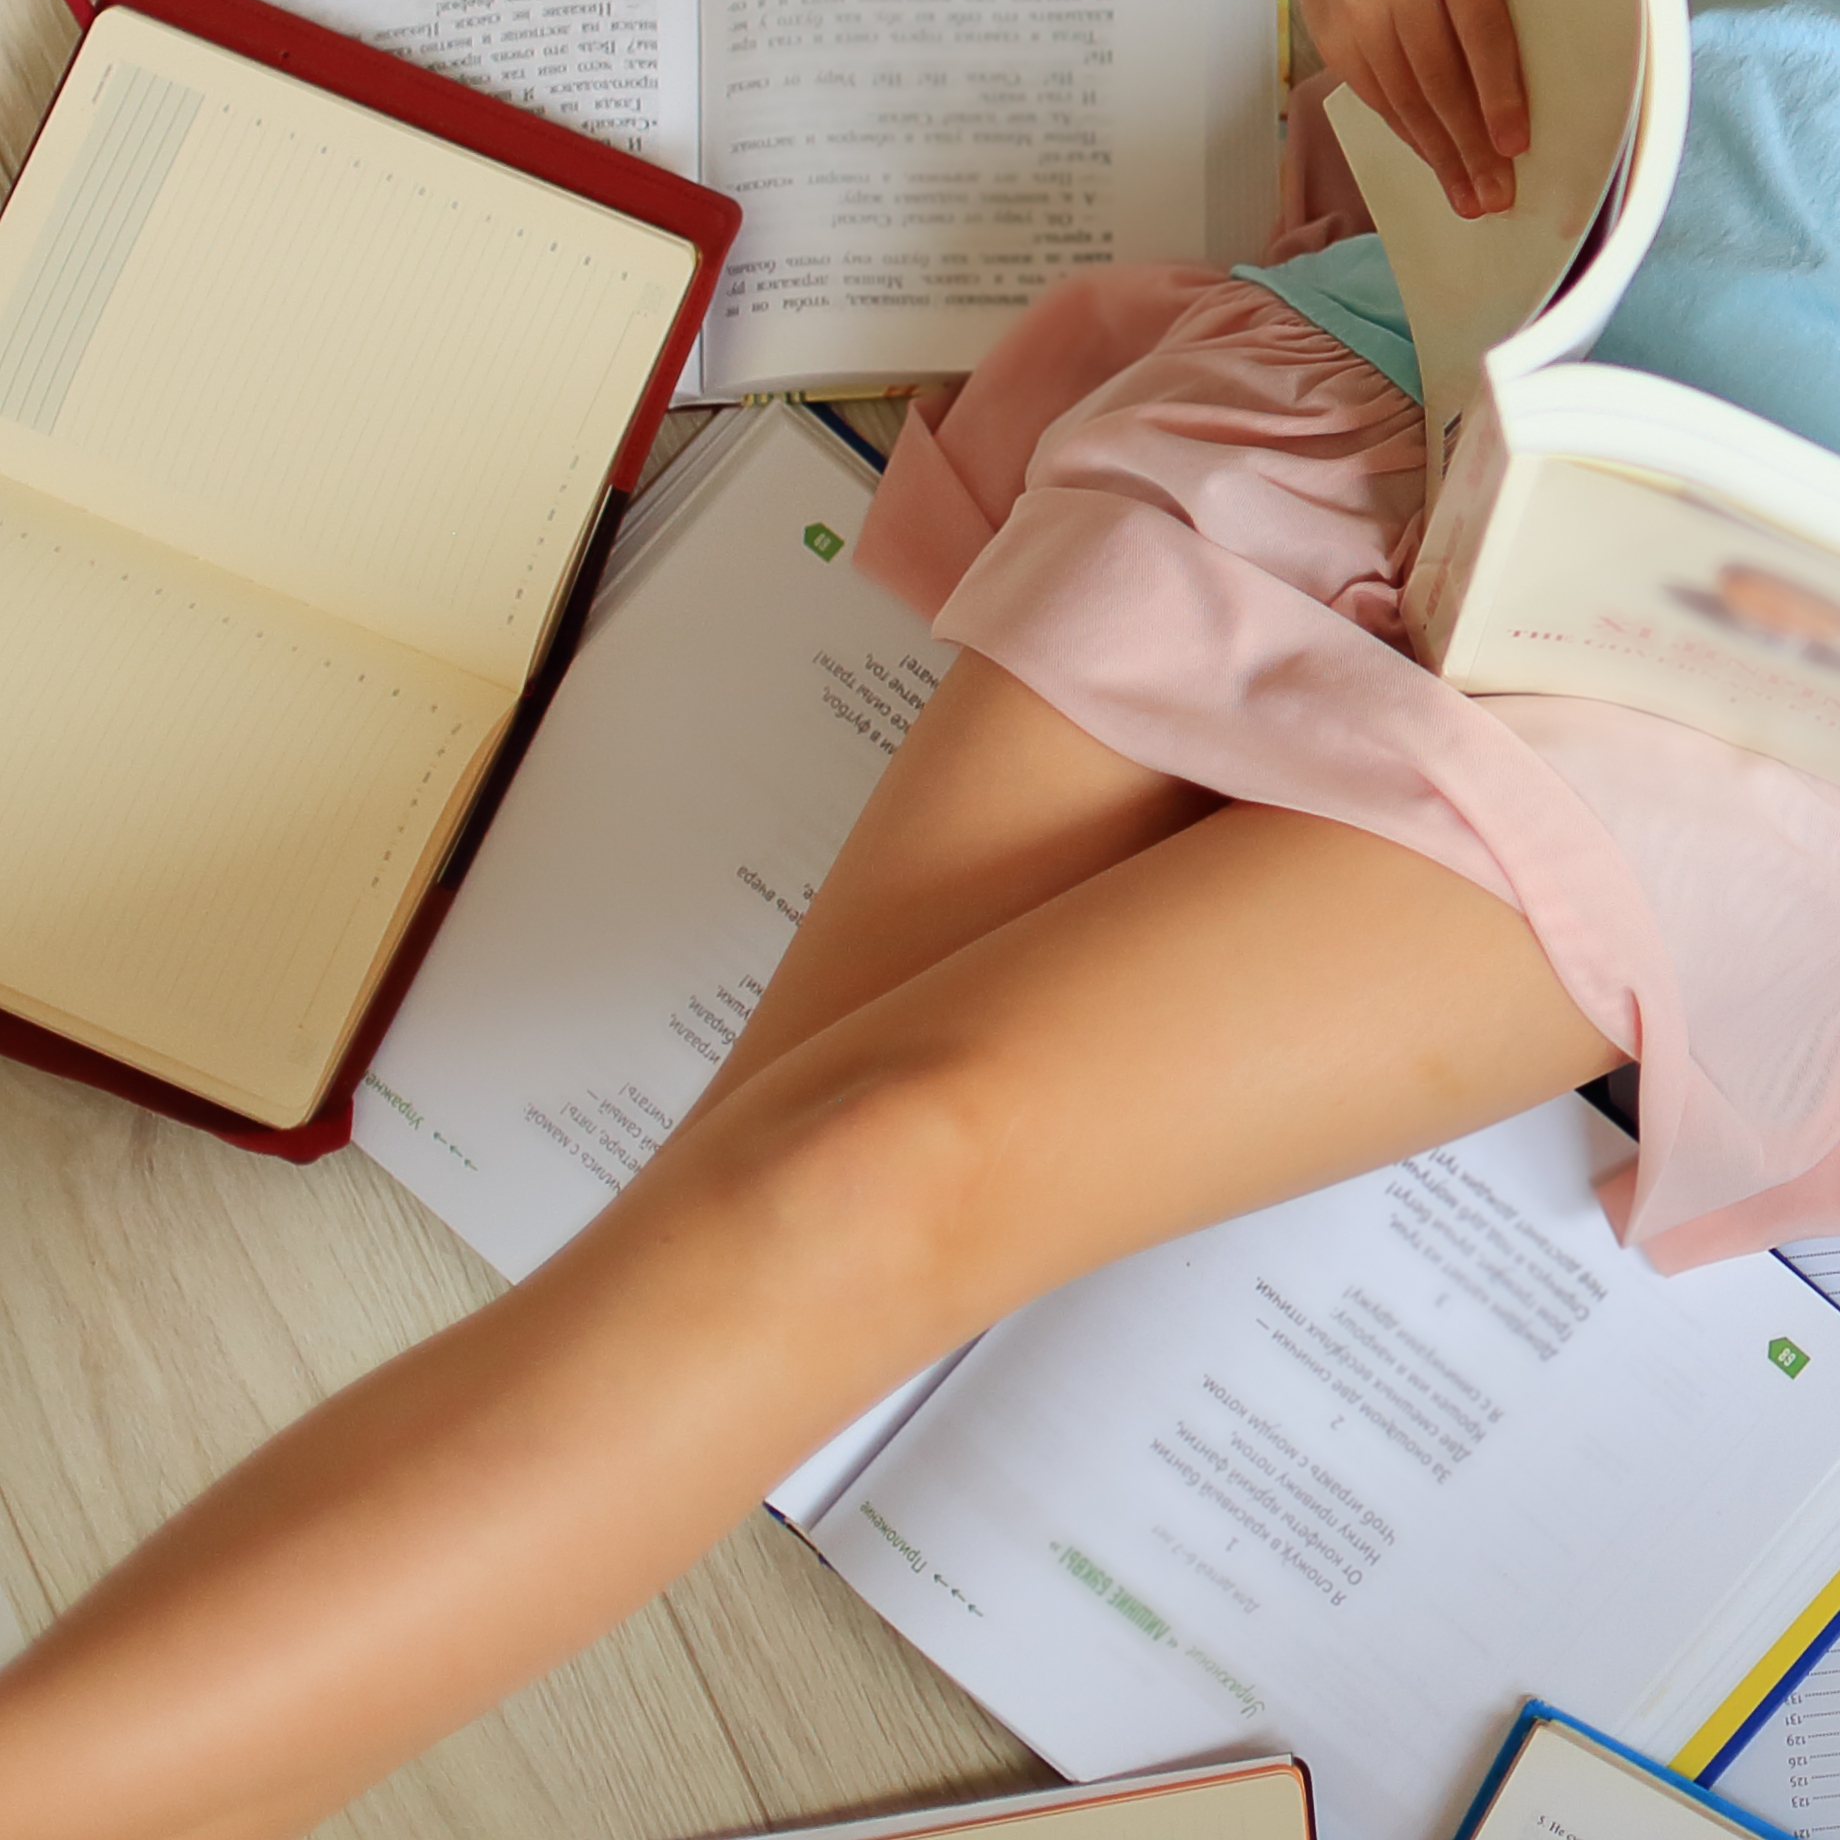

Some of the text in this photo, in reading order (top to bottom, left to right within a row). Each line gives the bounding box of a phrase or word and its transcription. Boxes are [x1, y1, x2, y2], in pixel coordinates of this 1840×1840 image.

[1252, 1276, 1307, 1328] птички.
[1148, 1438, 1270, 1542] красивый бантик
[1228, 1430, 1380, 1562] Нитку привяжу потом,
[1786, 1734, 1806, 1746] 129
[1788, 1756, 1807, 1769] 126
[1790, 1776, 1808, 1787] 125
[1791, 1796, 1810, 1808] 123
